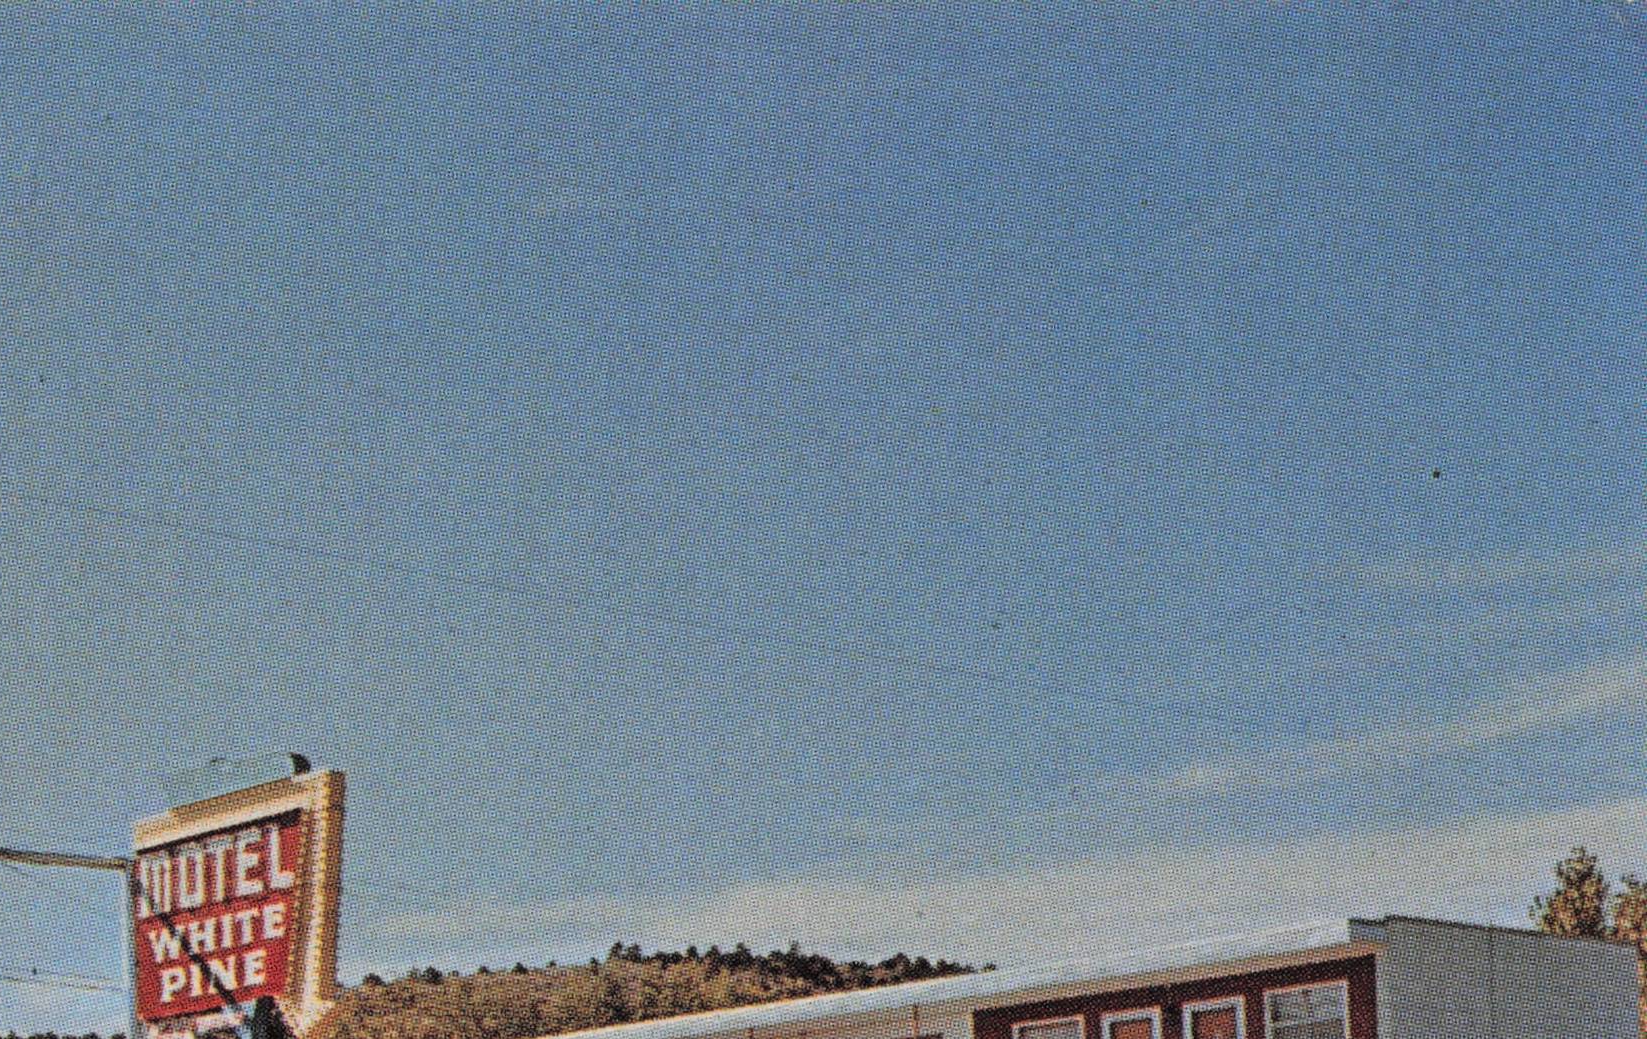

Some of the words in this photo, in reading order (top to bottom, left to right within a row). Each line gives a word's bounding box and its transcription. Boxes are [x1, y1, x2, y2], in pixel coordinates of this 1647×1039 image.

[138, 826, 295, 918] MOTEL
[148, 902, 287, 963] WHITE
[159, 949, 267, 1003] PINE
